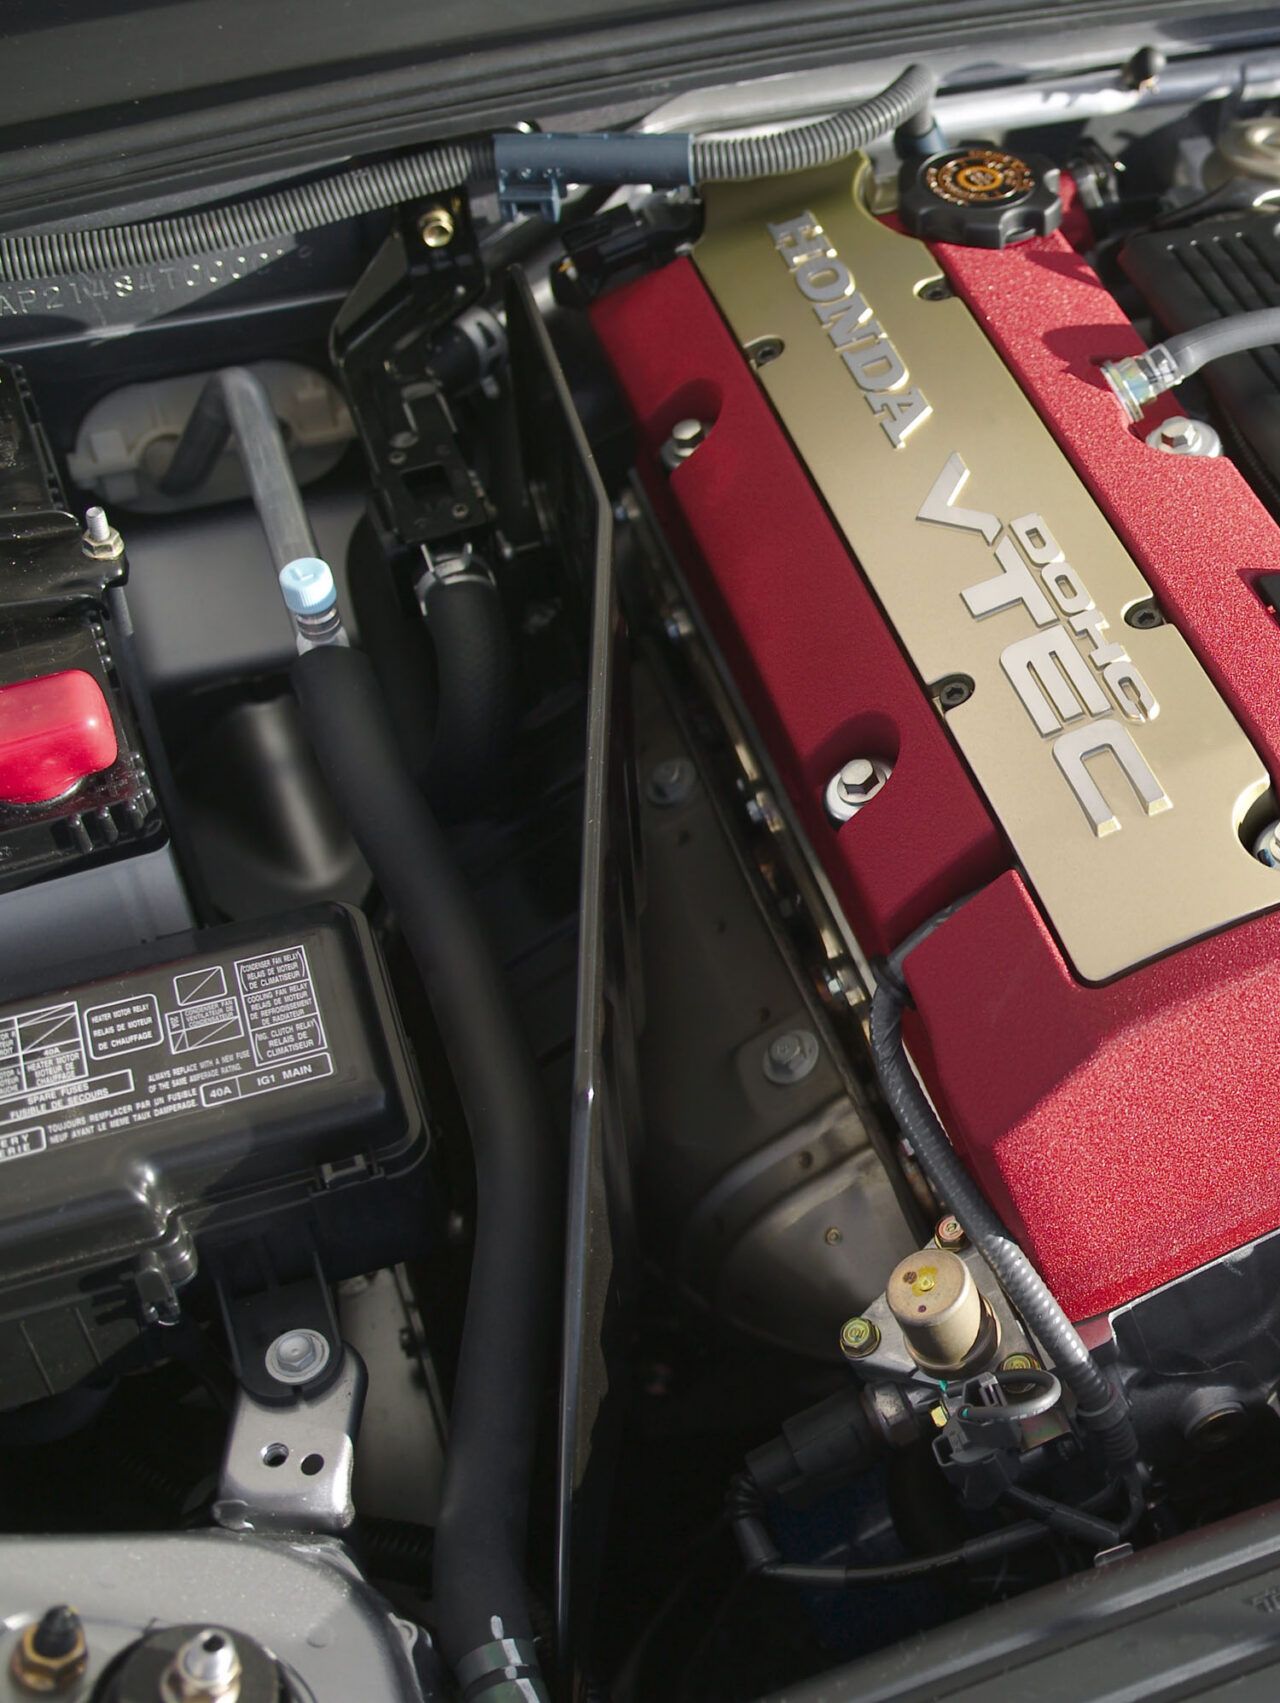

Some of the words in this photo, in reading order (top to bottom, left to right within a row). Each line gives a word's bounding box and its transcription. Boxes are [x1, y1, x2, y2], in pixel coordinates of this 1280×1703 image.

[767, 209, 934, 449] HONDA
[1008, 512, 1161, 724] DOHC
[915, 451, 1174, 839] VTEC
[260, 971, 300, 986] CLIMATISEUR
[247, 992, 273, 1003] COOLING
[289, 983, 307, 992] RELAY
[132, 1004, 149, 1012] RELAY
[93, 1026, 114, 1036] RELAIS
[127, 1017, 152, 1028] MOTEUR
[271, 1026, 294, 1036] CLUTCH
[98, 1042, 108, 1050] DE
[111, 1031, 152, 1046] CHAUFFAGE
[266, 1040, 314, 1057] CLIMATISEUR
[268, 1035, 294, 1047] RELAIS
[148, 1071, 171, 1081] ALWAYS
[209, 1087, 231, 1097] 40A
[257, 1075, 275, 1085] IG1
[282, 1065, 312, 1079] MAIN
[27, 1091, 56, 1104] SPARE
[61, 1083, 89, 1095] FUSES
[158, 1082, 170, 1090] THE
[10, 1105, 46, 1118] FUSIBLE
[51, 1100, 63, 1108] DE
[67, 1088, 109, 1104] SECOURS
[47, 1117, 86, 1132] TOUJOURS
[89, 1106, 132, 1121] REMPLACER
[136, 1101, 150, 1109] PAR
[167, 1088, 197, 1101] FUSIBLE
[70, 1126, 94, 1137] AYANT
[132, 1111, 151, 1121] TAUX
